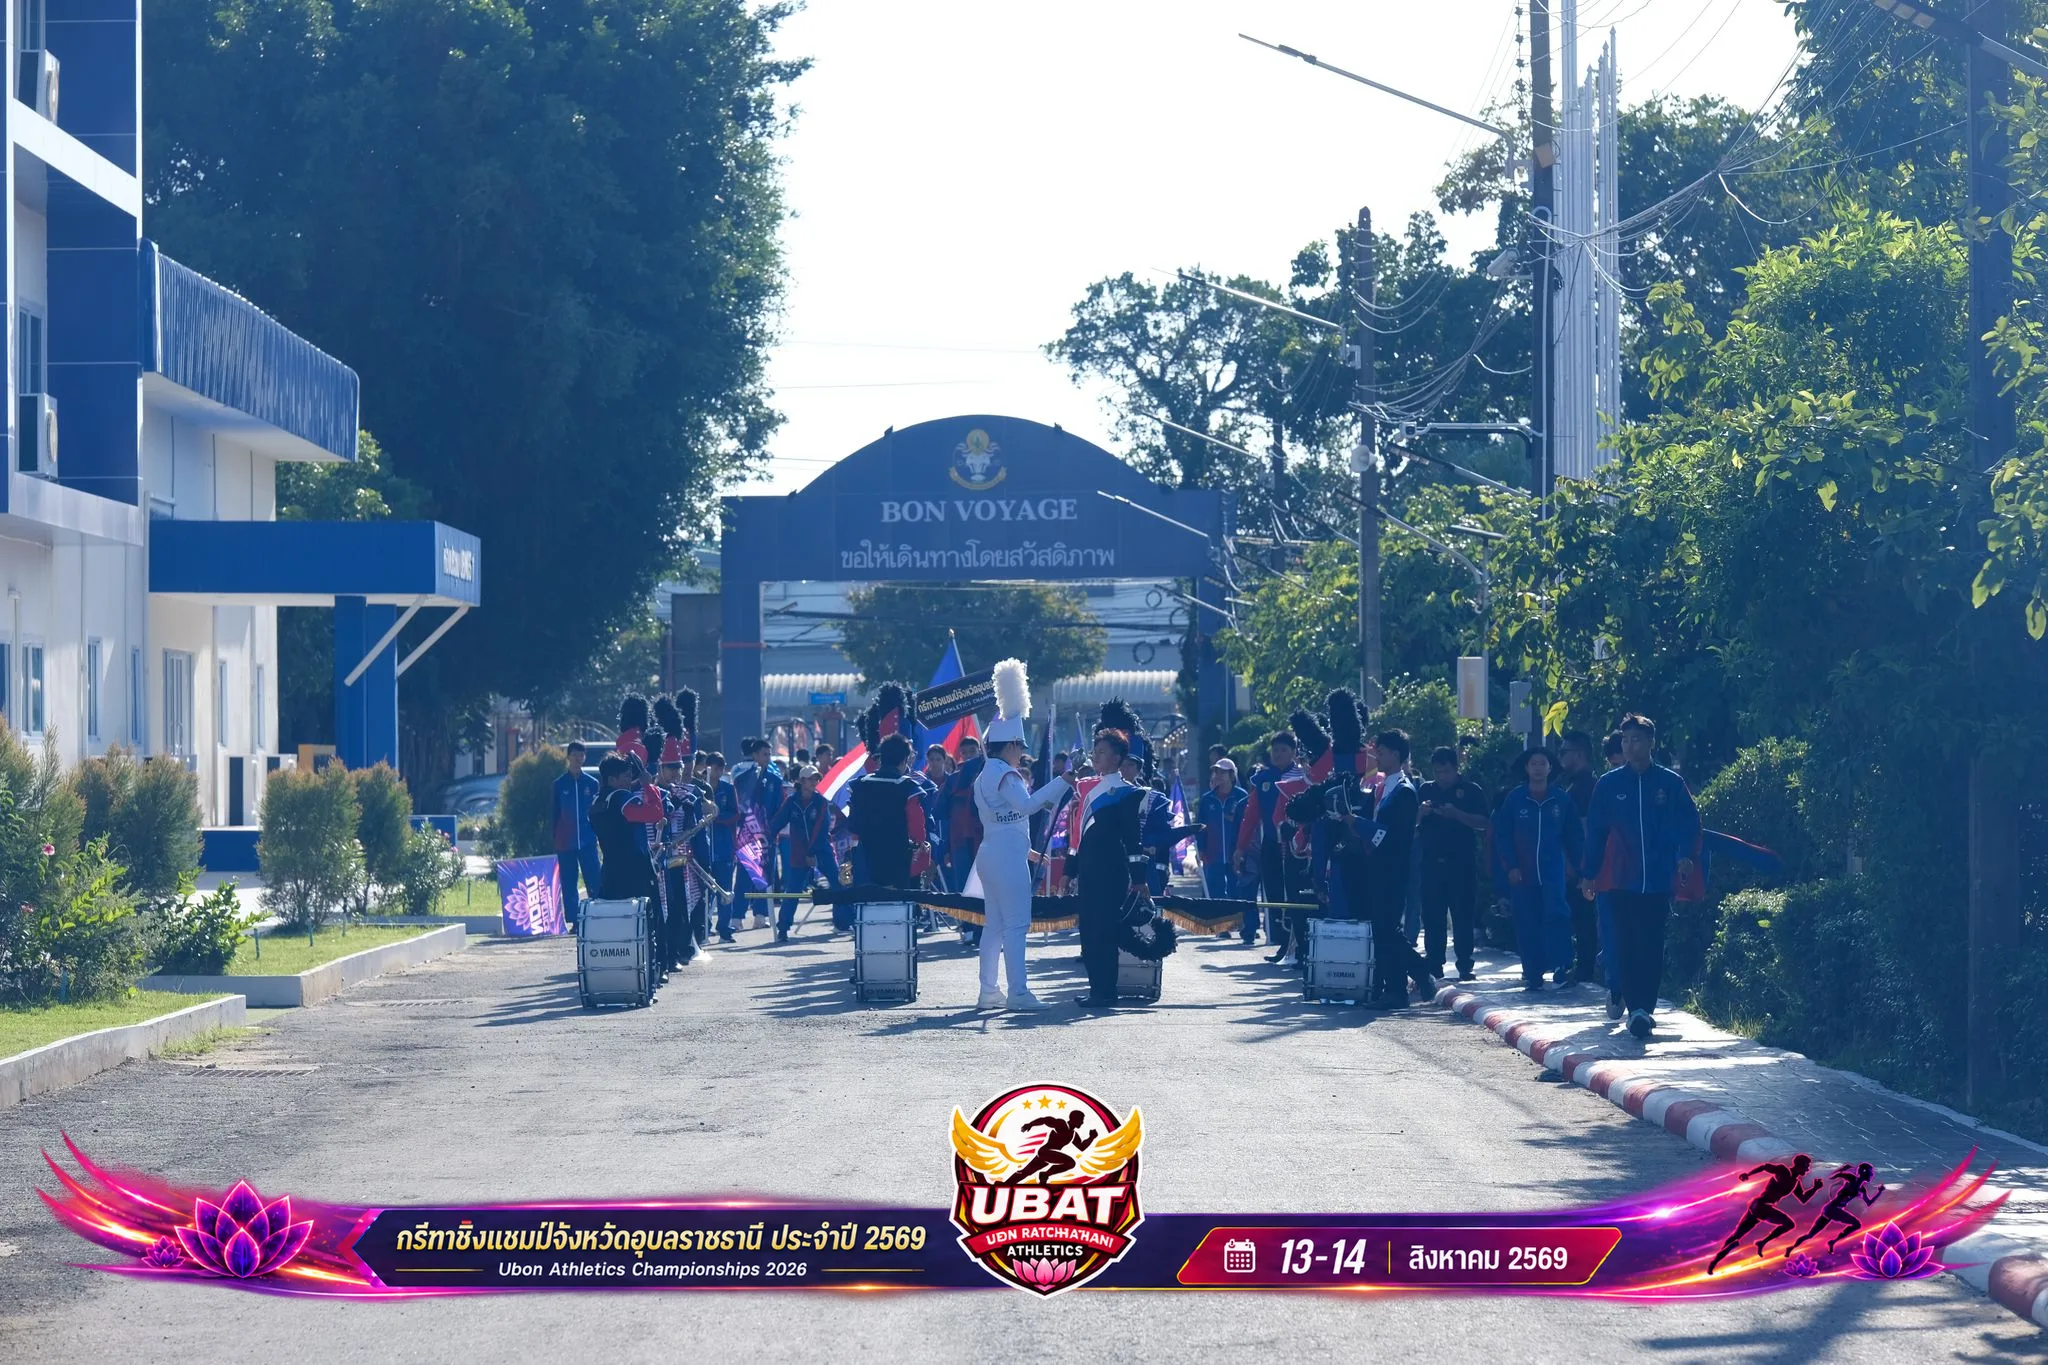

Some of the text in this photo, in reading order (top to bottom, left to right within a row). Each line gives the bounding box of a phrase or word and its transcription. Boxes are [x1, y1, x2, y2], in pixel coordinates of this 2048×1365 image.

[880, 498, 1078, 523] BON VOYAGE
[840, 539, 1115, 569] ขอให้เดินทางโดยสวัสดิภาพ
[925, 711, 941, 721] UBON
[942, 701, 972, 714] ATHLETICS
[599, 947, 631, 958] YAMAHA
